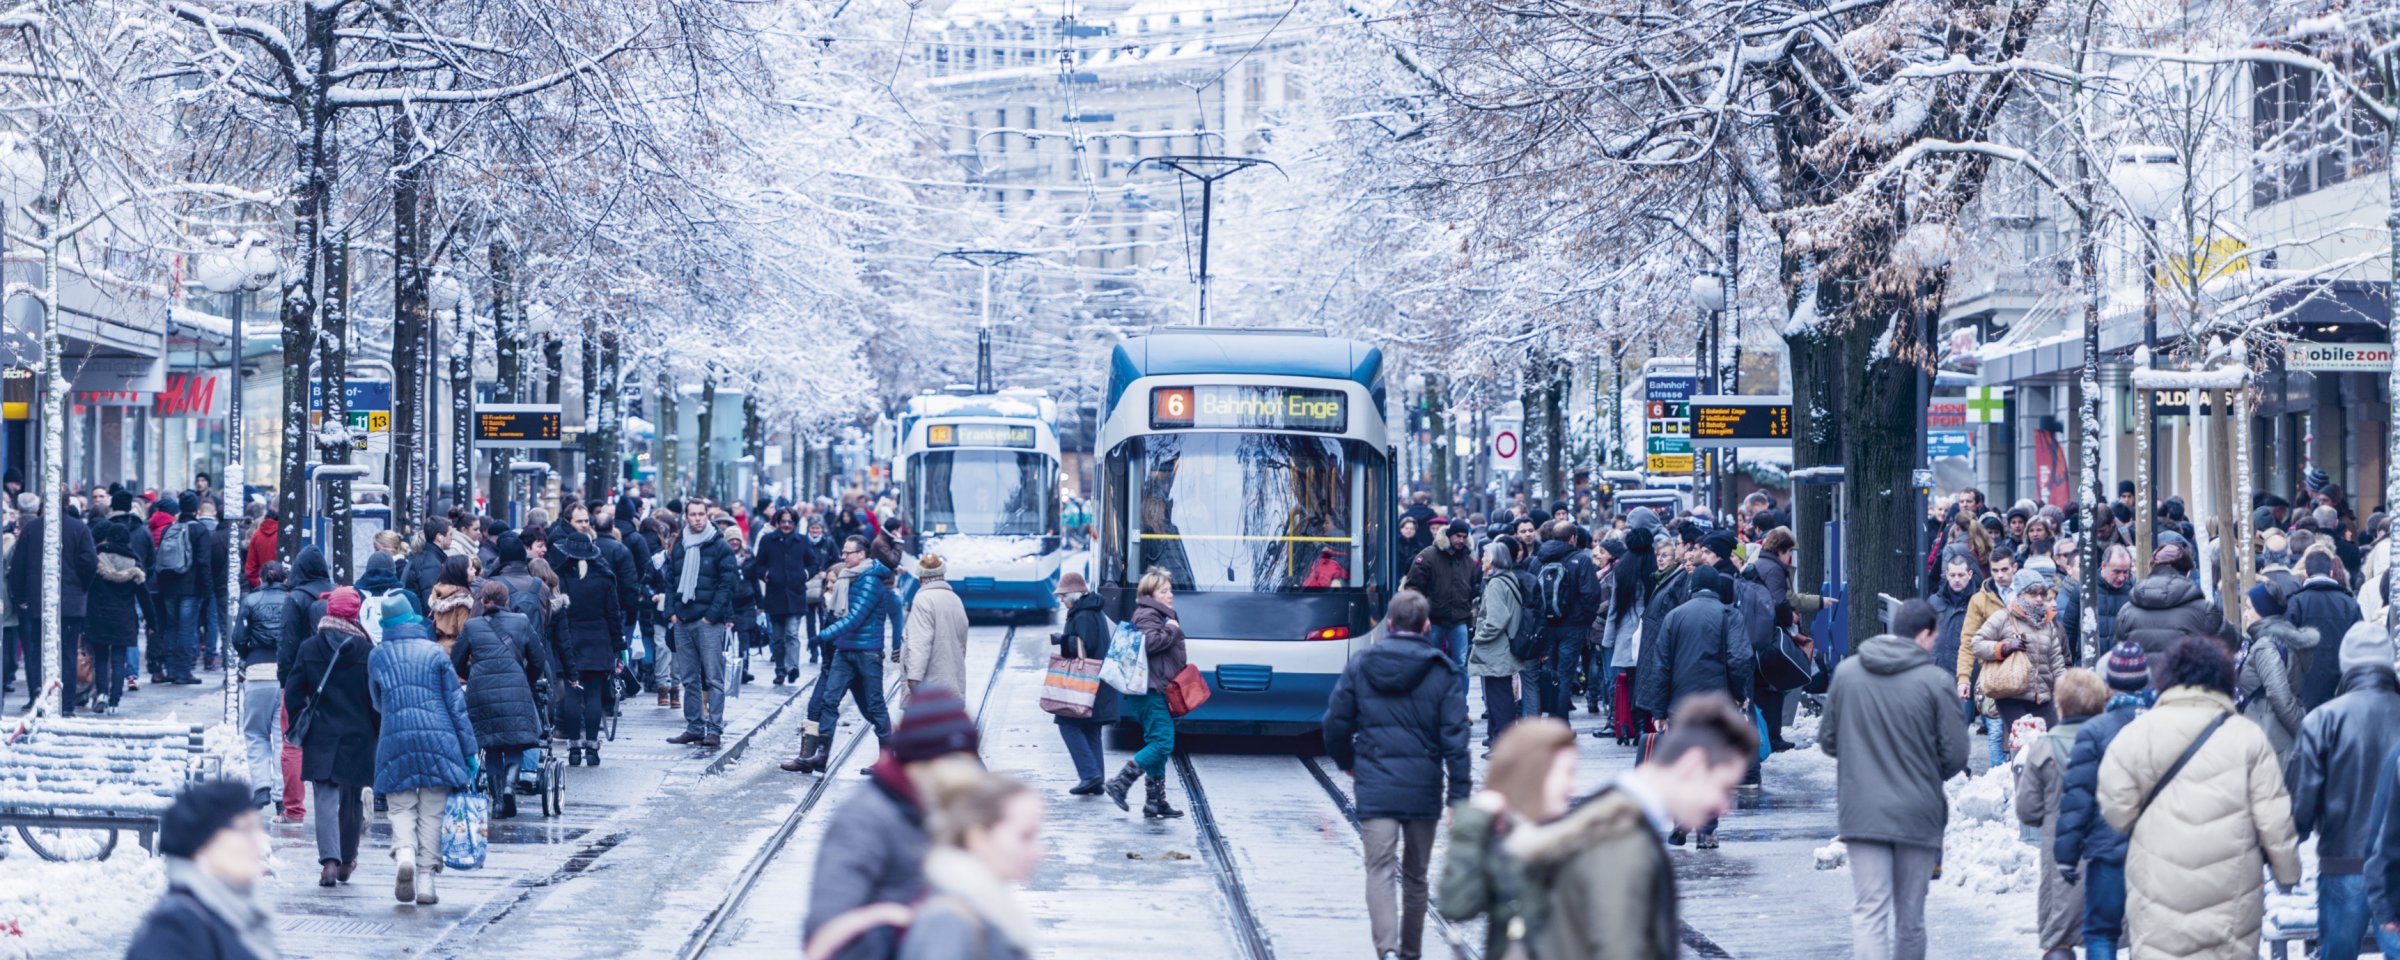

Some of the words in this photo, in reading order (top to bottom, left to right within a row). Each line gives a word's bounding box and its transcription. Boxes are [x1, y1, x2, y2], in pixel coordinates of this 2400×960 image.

[1649, 381, 1690, 389] Bahnhof-
[156, 374, 217, 417] H&M
[1649, 390, 1683, 398] strasse
[1167, 393, 1185, 416] 6
[1203, 393, 1284, 416] Bahnhof
[1288, 395, 1339, 420] Enge
[1653, 404, 1663, 416] 6
[1670, 405, 1679, 416] 7
[356, 415, 369, 430] 11
[371, 415, 388, 428] 13
[1654, 440, 1665, 451] 11
[1651, 458, 1664, 468] 13
